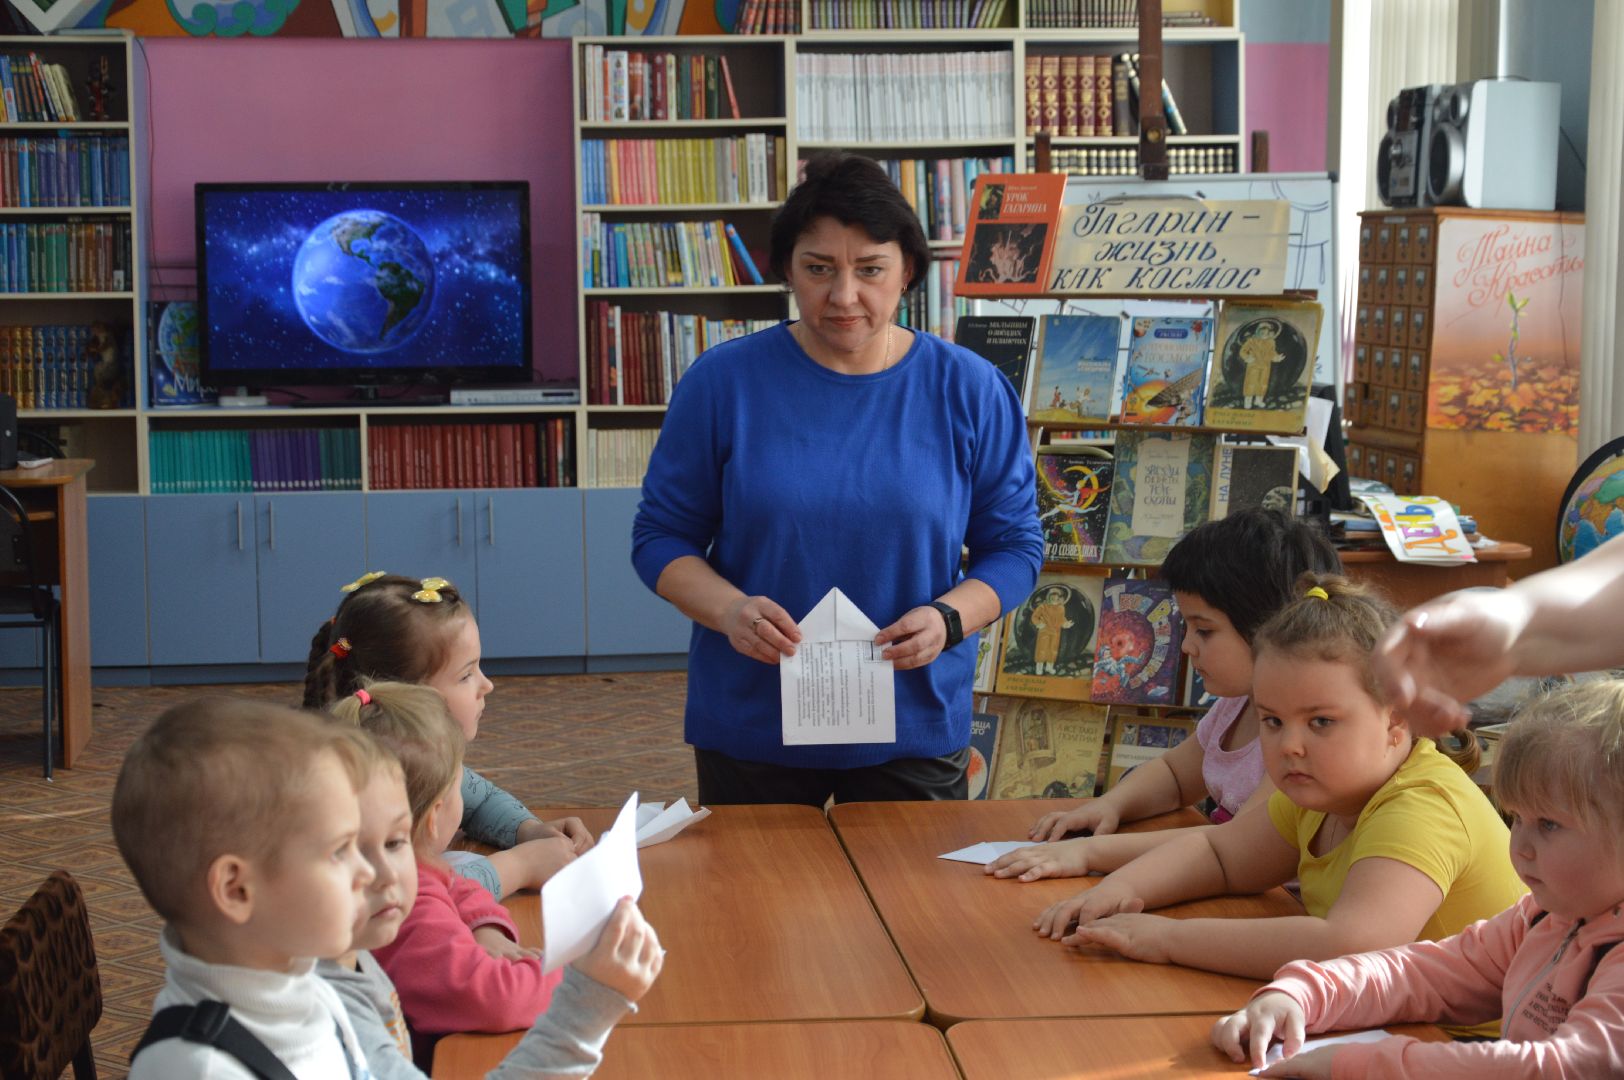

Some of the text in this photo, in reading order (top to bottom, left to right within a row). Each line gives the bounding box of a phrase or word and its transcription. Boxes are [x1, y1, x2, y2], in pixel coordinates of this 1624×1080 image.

[1003, 203, 1048, 214] ГАГАРИНА
[1006, 192, 1029, 203] УРОК
[1452, 223, 1553, 288] Тайна
[1218, 447, 1233, 503] НА ЛУНЕ
